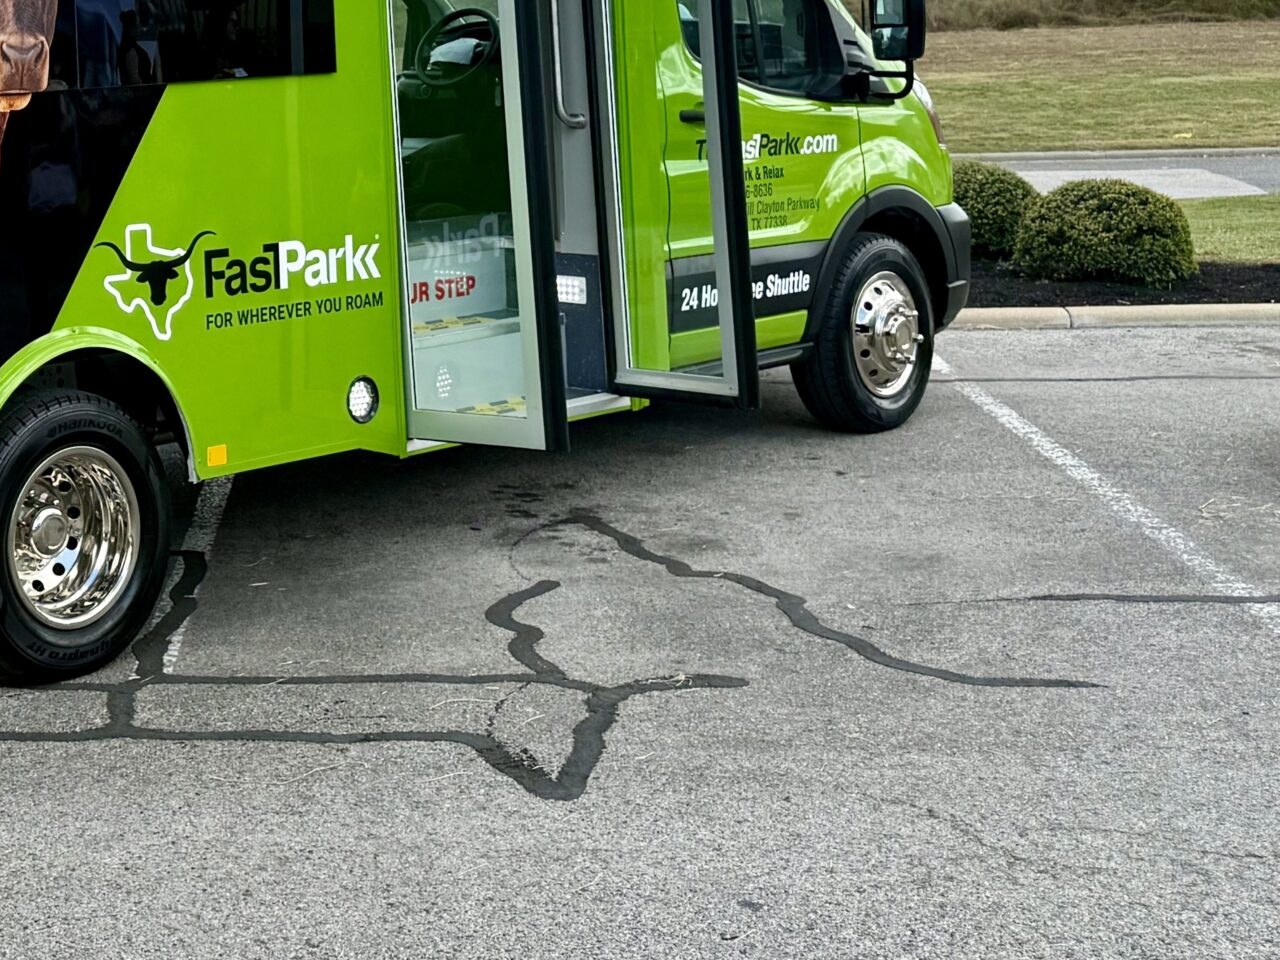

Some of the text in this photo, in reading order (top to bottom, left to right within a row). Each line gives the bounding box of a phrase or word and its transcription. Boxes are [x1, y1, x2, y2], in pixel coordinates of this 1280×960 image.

[755, 166, 762, 180] &
[763, 165, 785, 180] Relax
[745, 183, 773, 199] 6-8636
[757, 200, 785, 216] Clayton
[787, 197, 820, 212] Parkway
[752, 218, 762, 231] TX
[435, 276, 476, 300] STEP
[681, 287, 699, 311] 24
[701, 284, 719, 308] Ho
[766, 270, 811, 298] Shuttle
[206, 291, 384, 330] FOR WHEREVER YOU ROAM
